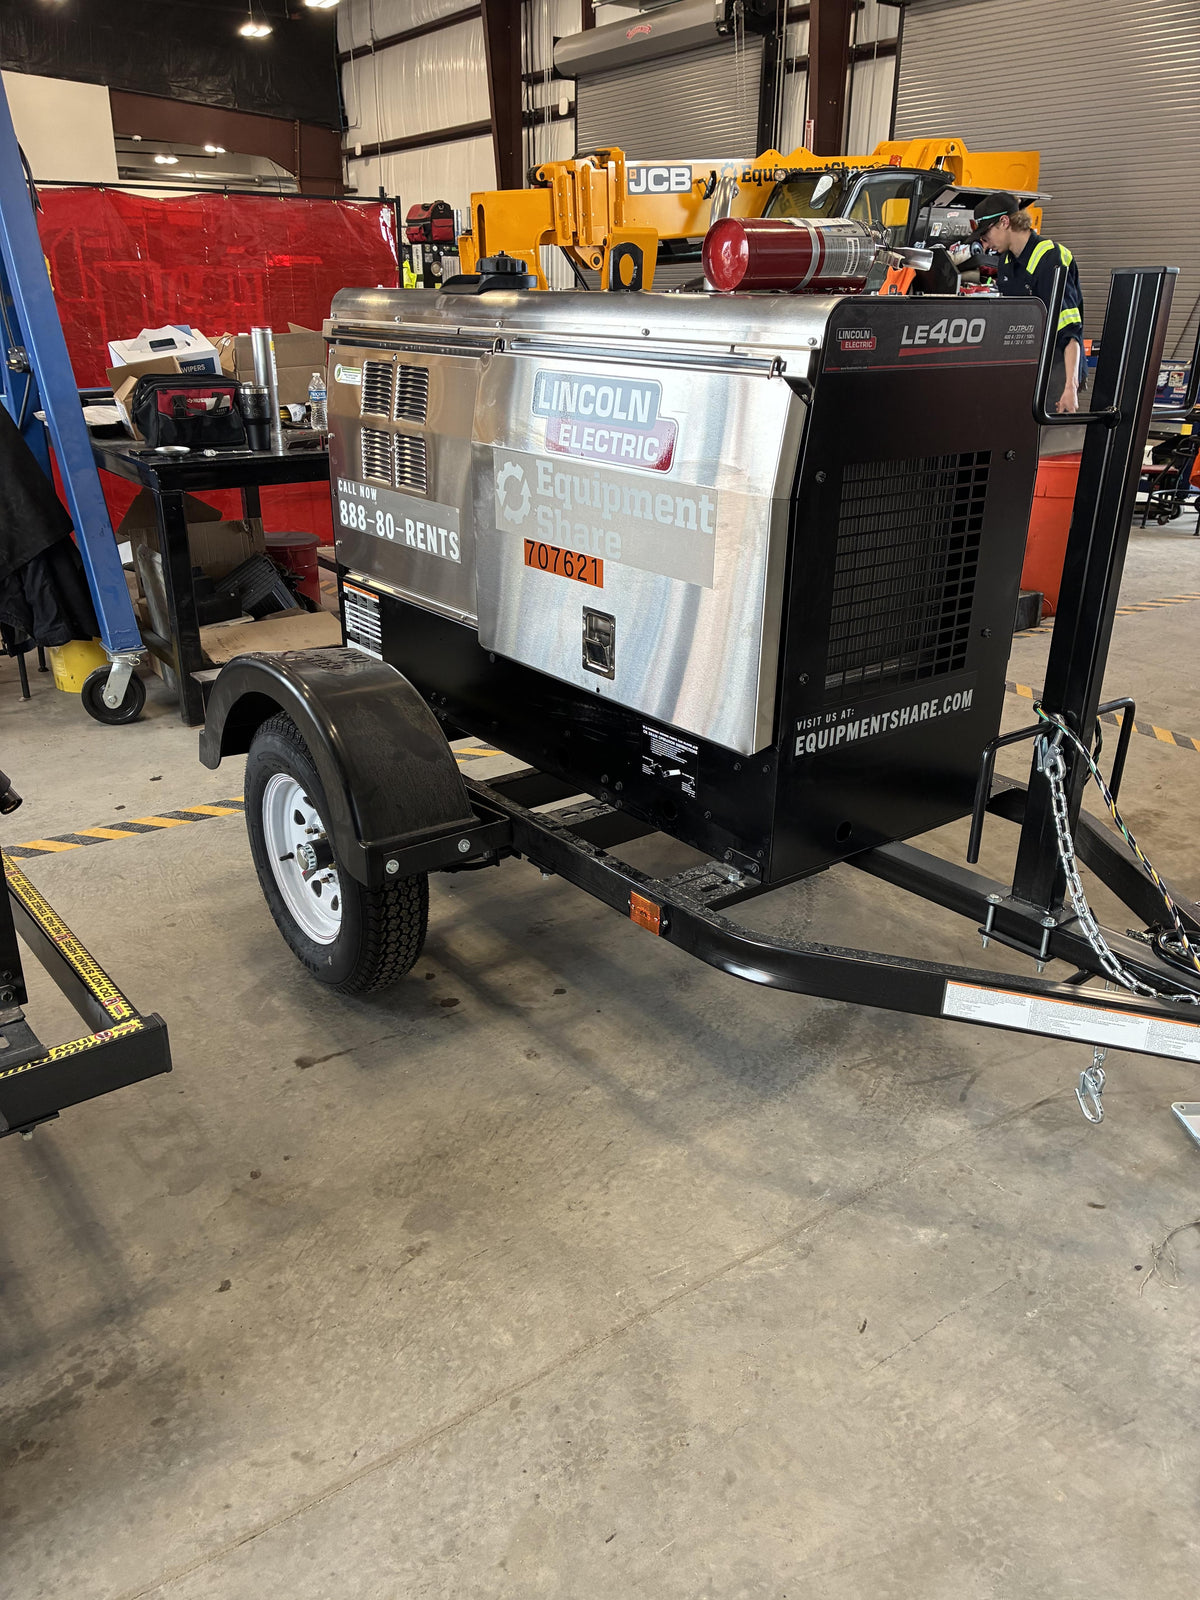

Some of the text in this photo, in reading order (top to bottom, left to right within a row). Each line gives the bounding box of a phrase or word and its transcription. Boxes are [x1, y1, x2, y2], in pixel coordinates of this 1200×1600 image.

[629, 167, 692, 192] JCB
[838, 330, 870, 339] LINCOLN
[901, 318, 986, 345] LE400
[181, 364, 206, 373] WIPERS
[538, 378, 652, 423] LINCOLN
[558, 423, 661, 462] ELECTRIC
[338, 480, 377, 501] CALL NOW
[535, 459, 714, 535] Equipment
[340, 500, 460, 560] 888-80-RENTS
[535, 504, 622, 560] Share
[526, 539, 599, 585] 707621
[794, 689, 974, 757] EQUIPMENTSHARE.COM
[797, 708, 855, 731] VISIT US AT:
[62, 939, 112, 998] DO NOT STAND HERE
